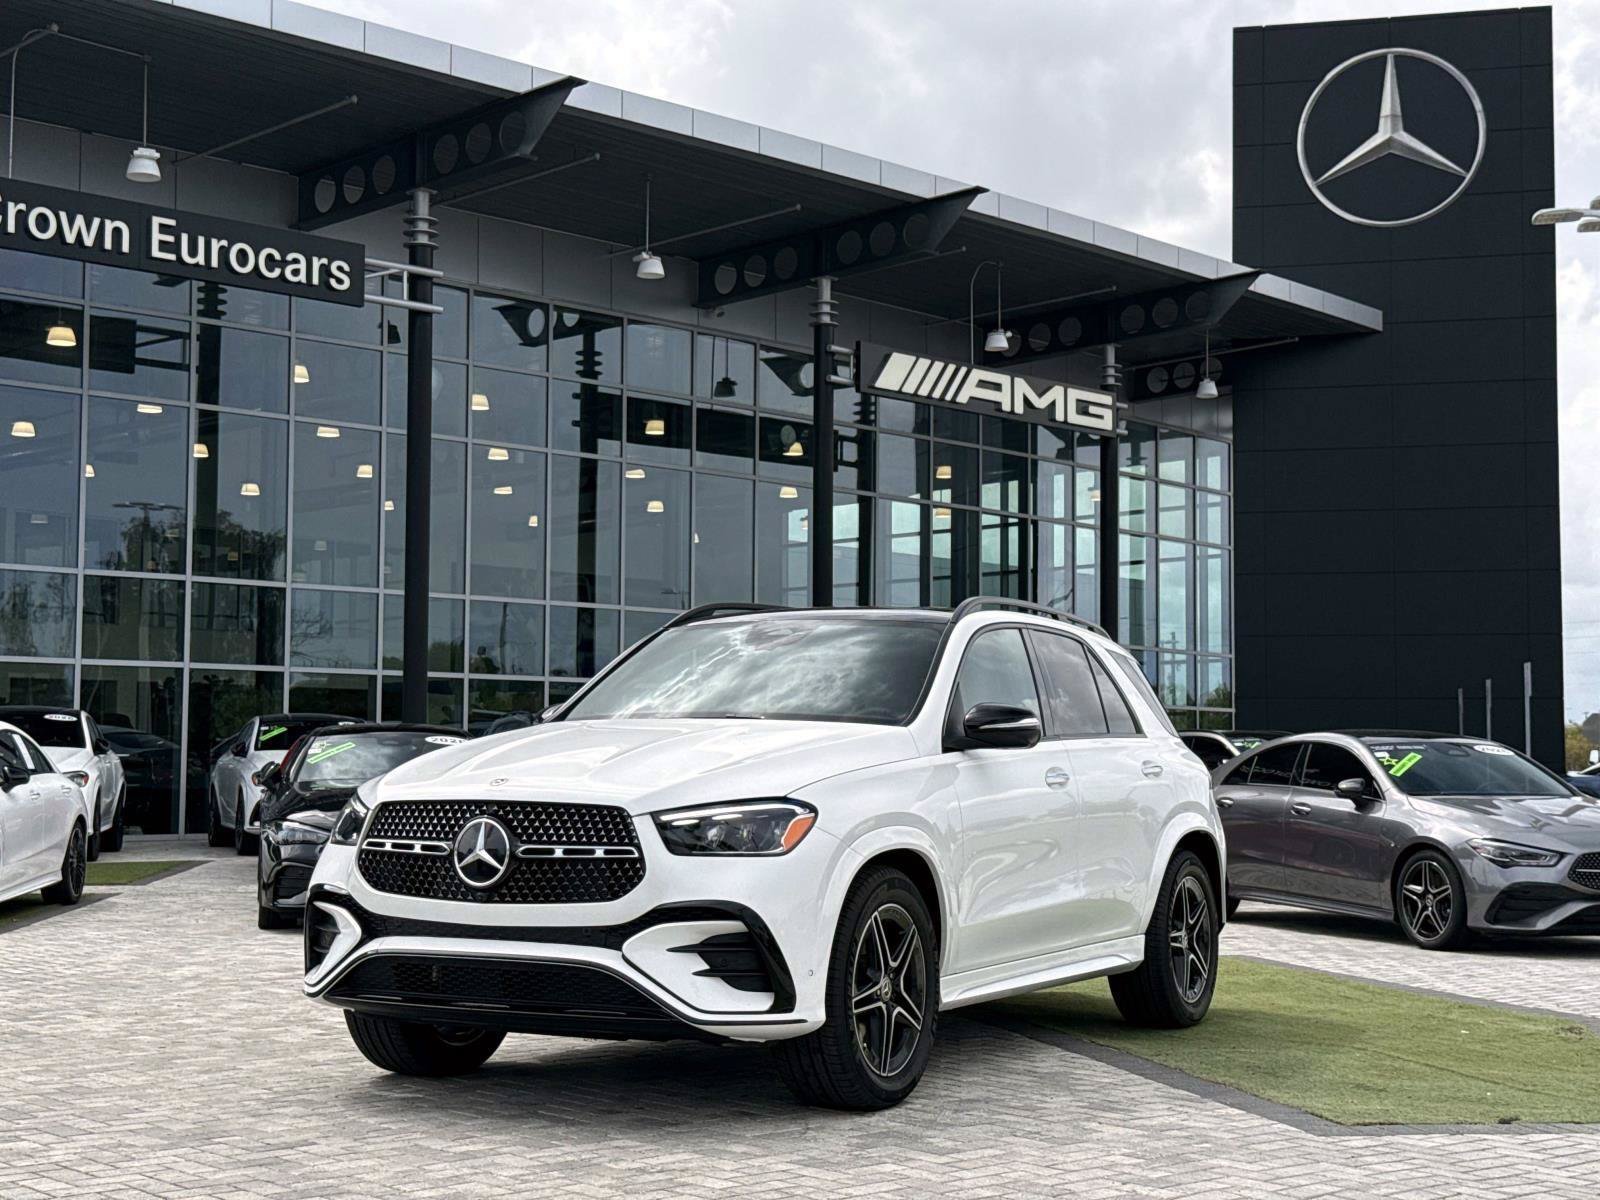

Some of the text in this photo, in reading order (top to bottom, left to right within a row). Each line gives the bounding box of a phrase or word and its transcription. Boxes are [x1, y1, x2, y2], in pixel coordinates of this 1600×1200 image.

[0, 193, 351, 291] rown Eurocars
[956, 368, 1113, 431] AMG
